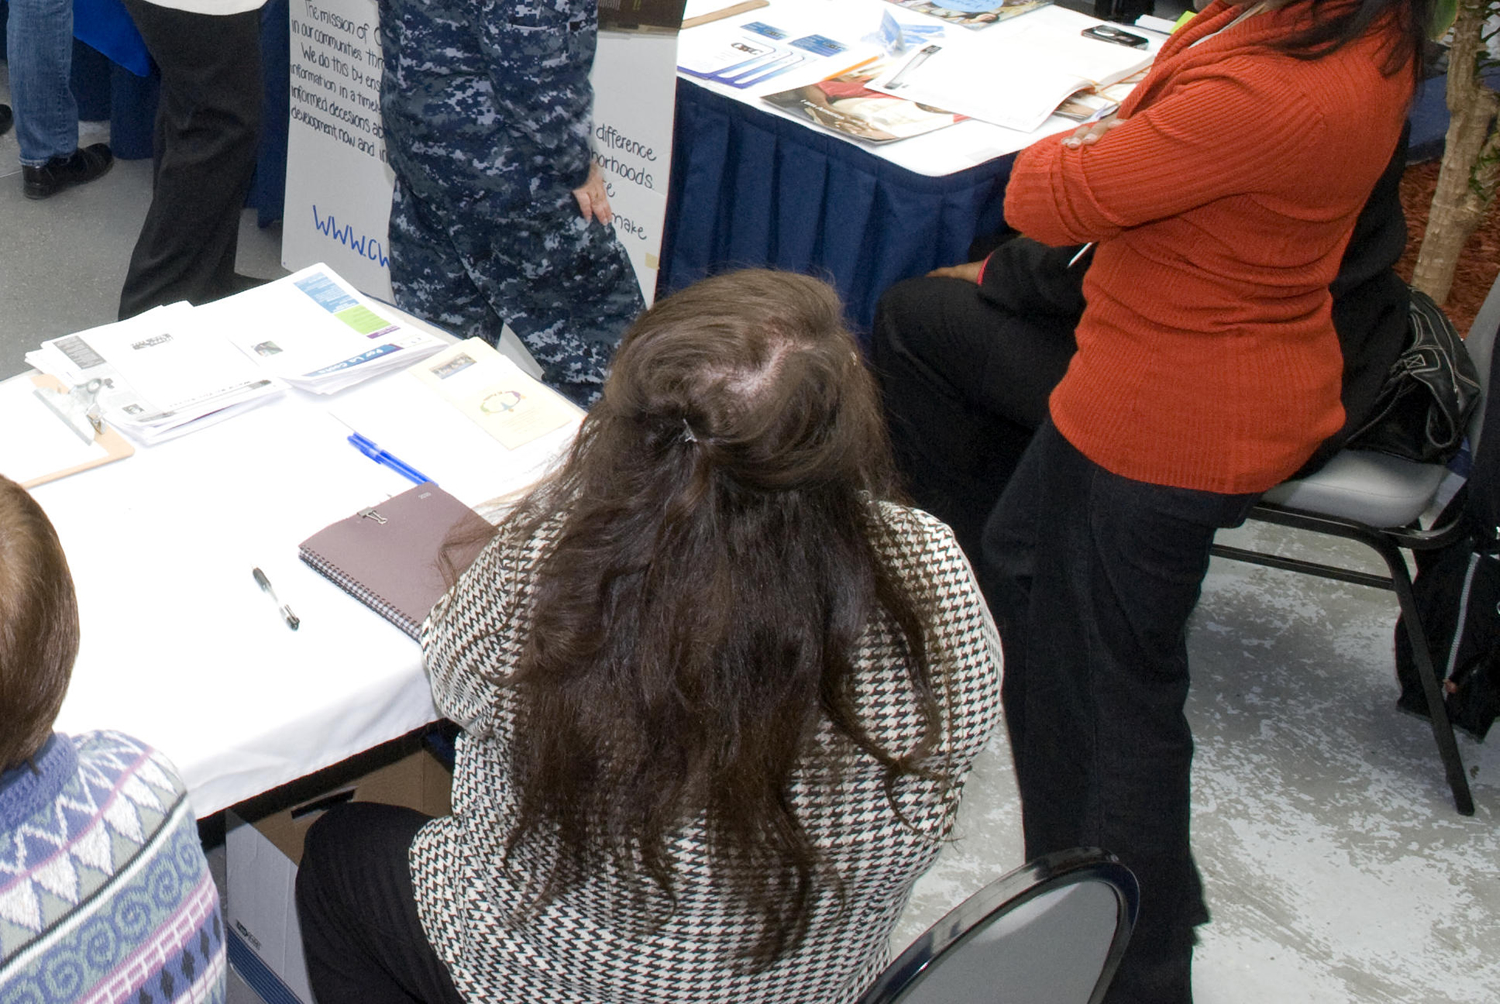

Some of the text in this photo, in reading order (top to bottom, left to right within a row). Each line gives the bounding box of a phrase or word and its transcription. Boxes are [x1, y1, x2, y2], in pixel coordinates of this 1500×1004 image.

[301, 42, 317, 64] We
[318, 51, 330, 69] do
[331, 56, 349, 77] this
[352, 65, 363, 85] by
[320, 10, 356, 36] mission
[357, 23, 370, 45] of
[595, 123, 657, 161] difference
[357, 137, 375, 157] and
